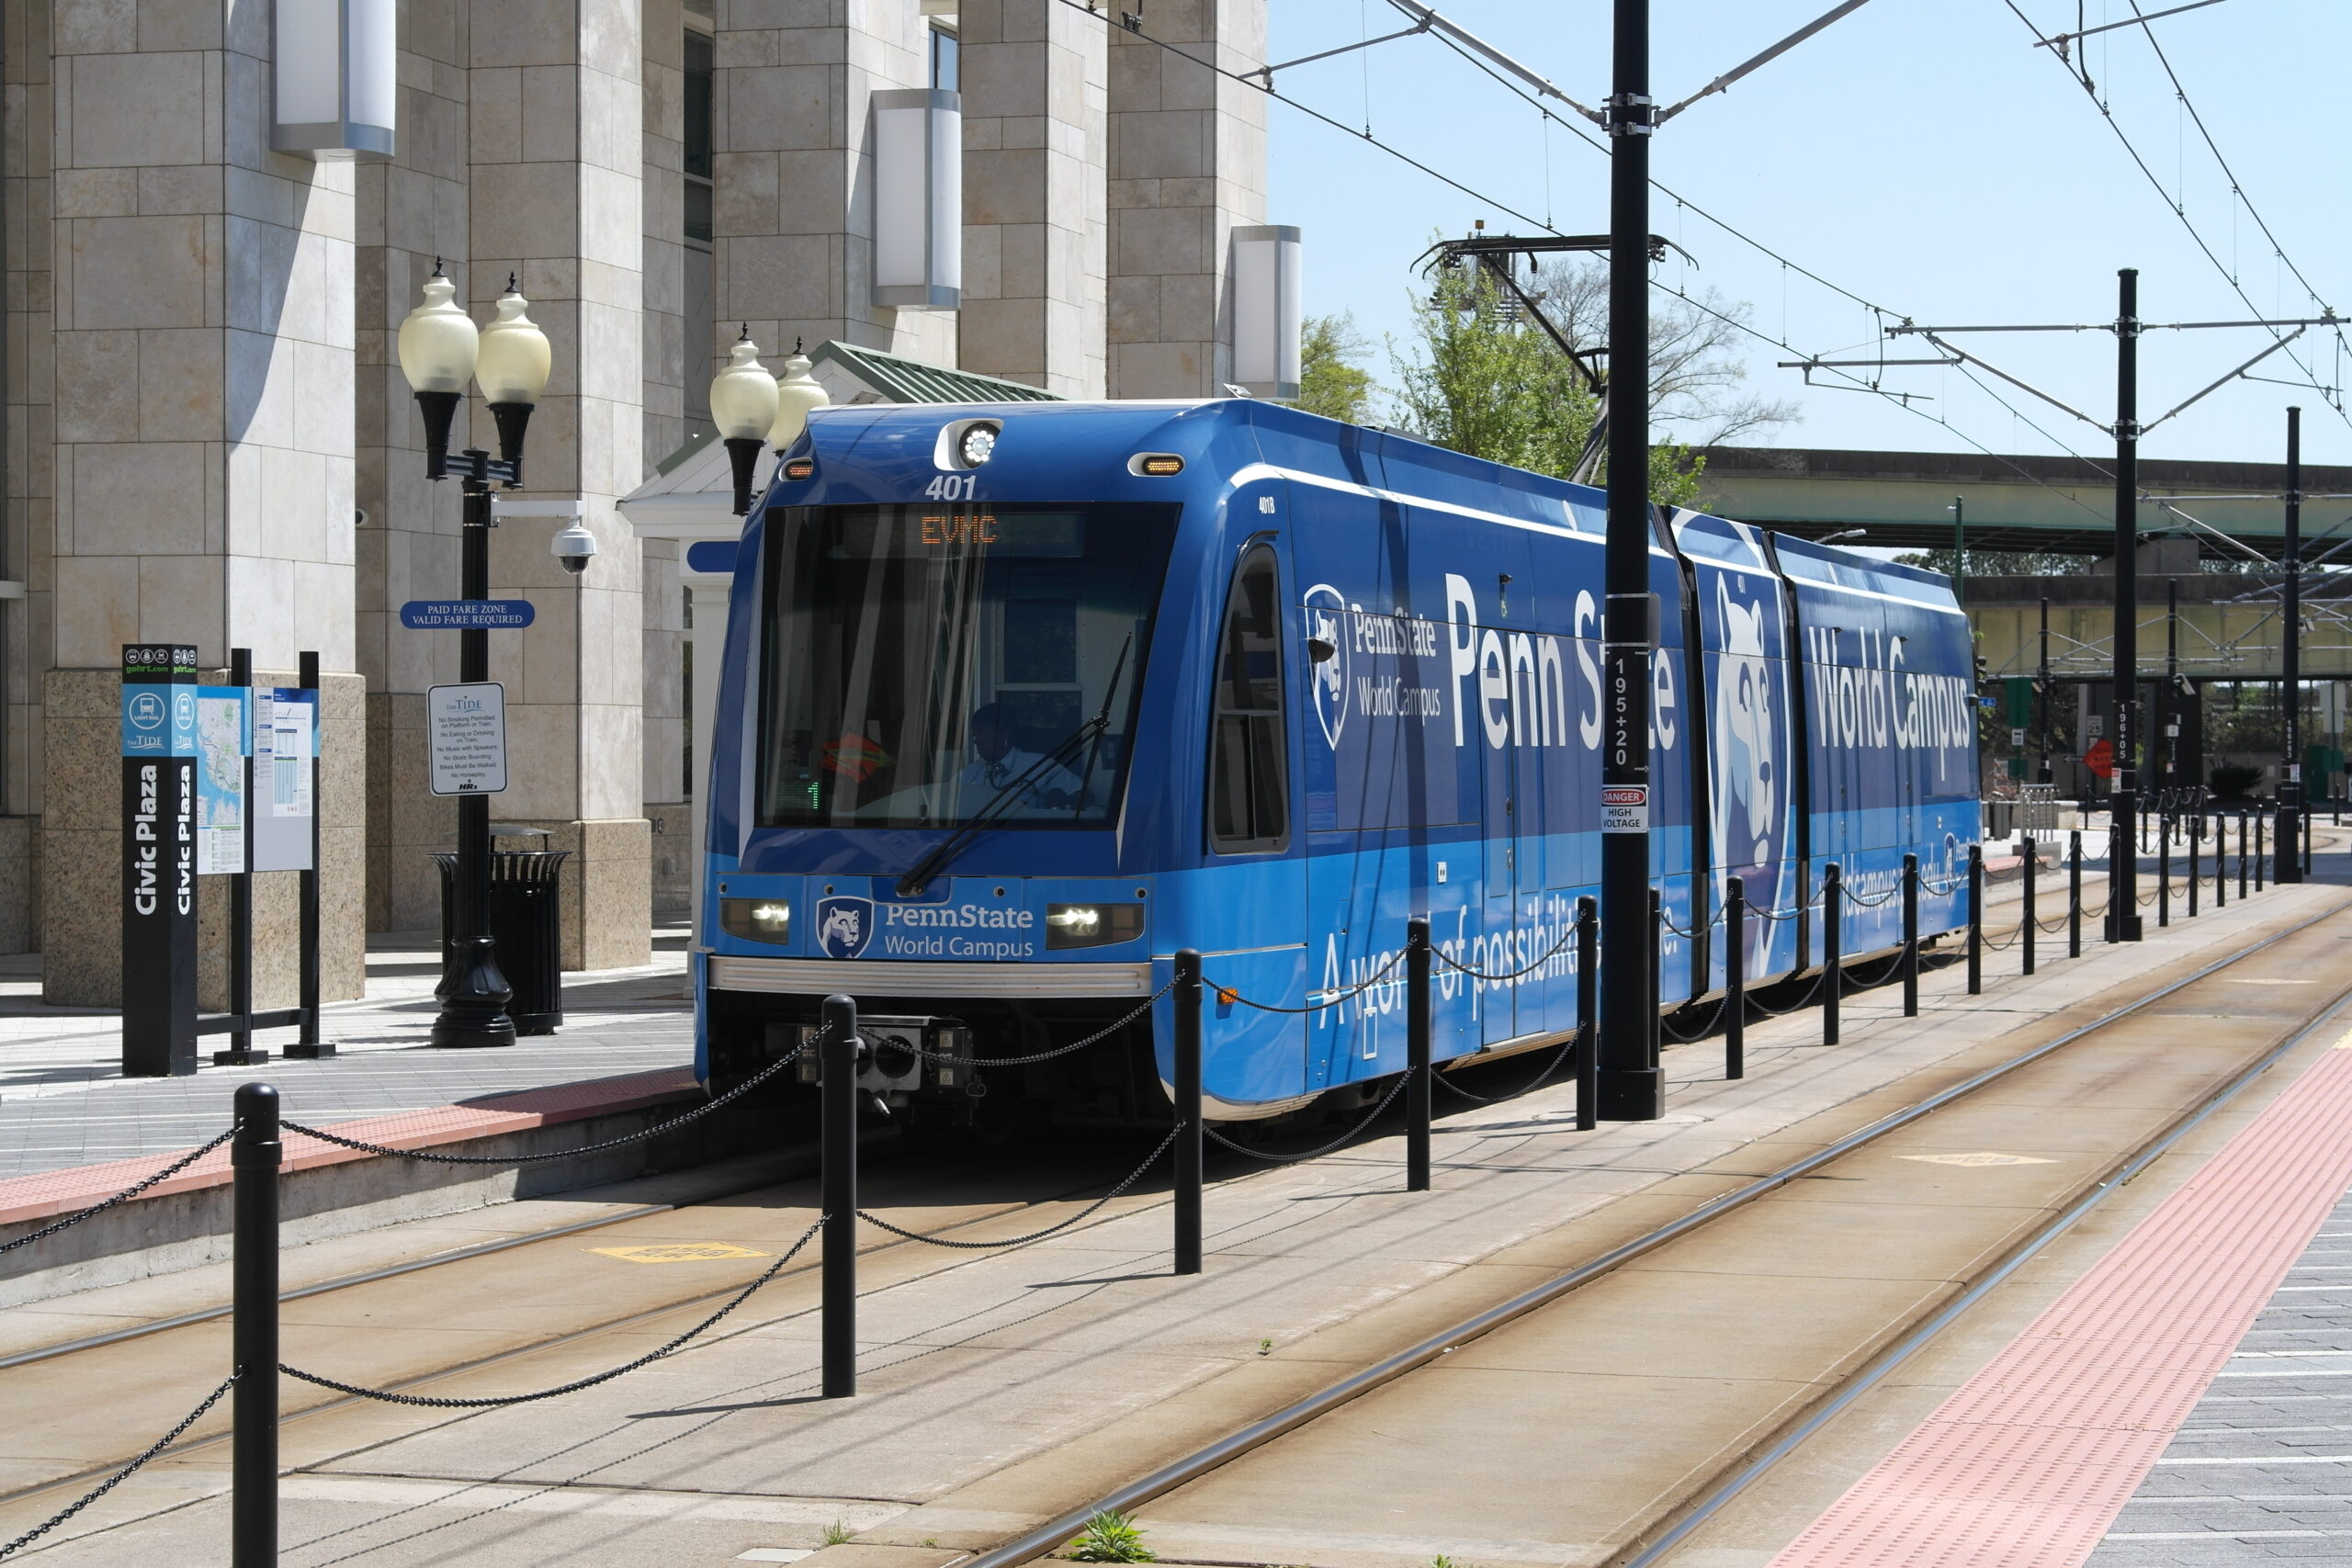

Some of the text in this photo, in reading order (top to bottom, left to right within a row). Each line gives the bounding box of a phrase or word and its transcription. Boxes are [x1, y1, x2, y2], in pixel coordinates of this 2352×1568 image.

[925, 475, 976, 501] 401
[922, 515, 997, 543] EVMC
[412, 615, 523, 626] VALID FARE REQUIRED
[427, 604, 507, 615] PAID FARE ZONE
[1351, 604, 1437, 658] PennState
[126, 665, 168, 674] gohrt.com
[1445, 573, 1566, 750] Penn
[1357, 675, 1441, 727] World Campus
[1809, 626, 1888, 750] World
[1889, 635, 1971, 781] Campus
[136, 735, 163, 746] TIDE
[808, 782, 819, 809] 1
[1603, 792, 1640, 802] DANGER
[1602, 818, 1641, 828] VOLTAGE
[1608, 808, 1632, 817] HIGH
[134, 764, 157, 916] Civic Plaza
[177, 764, 191, 916] Civic Plaza
[886, 904, 1034, 929] PennState
[885, 935, 1034, 962] World Campus
[1319, 932, 1345, 1030] A
[1351, 910, 1431, 1020] wor
[1439, 904, 1467, 1001] of
